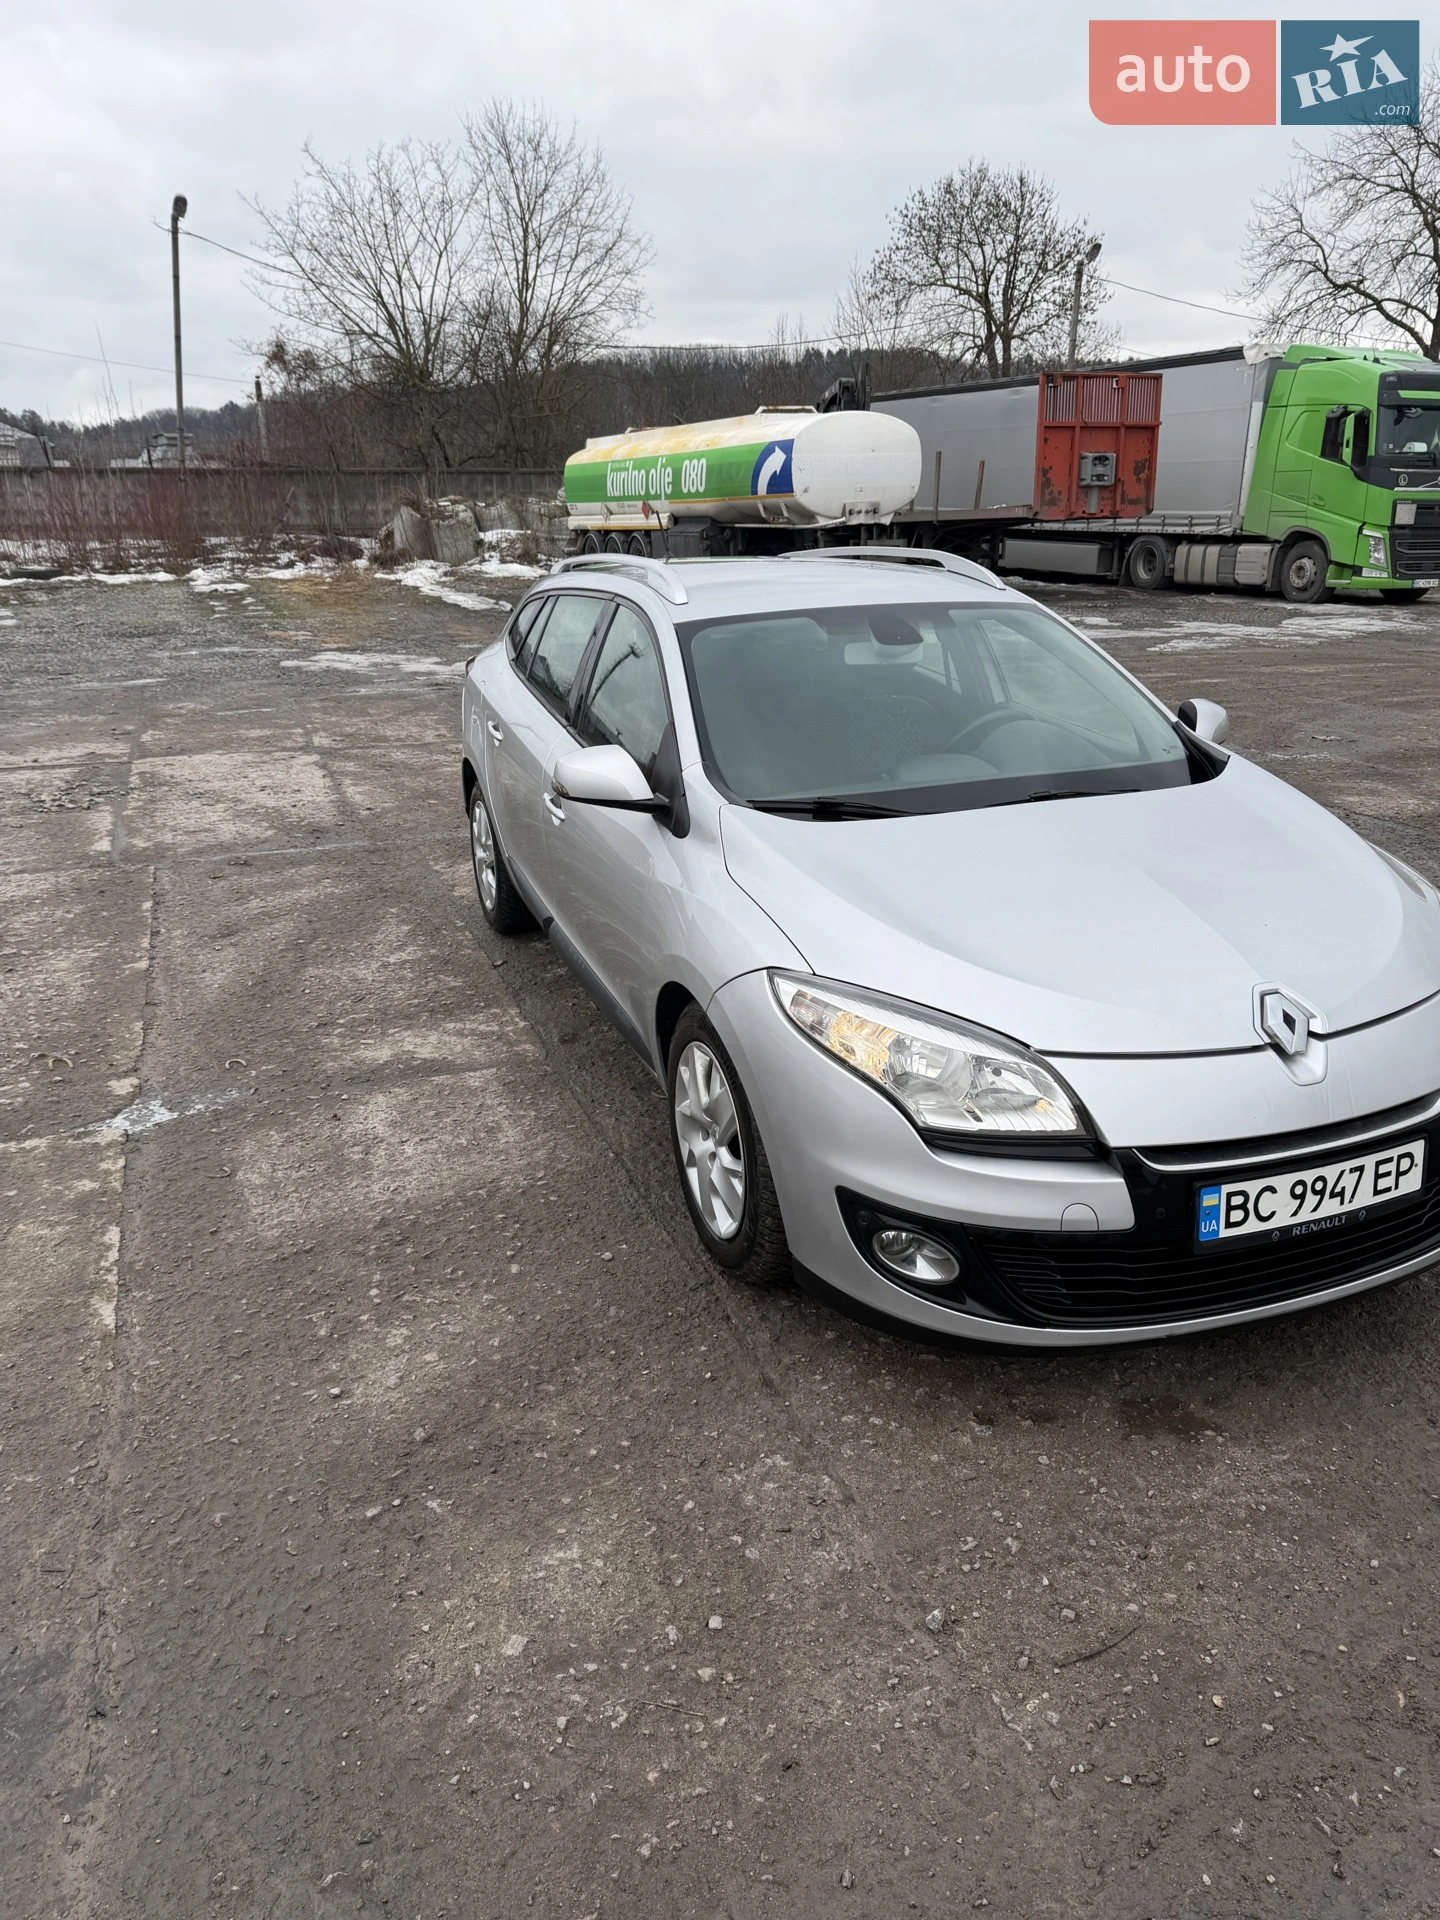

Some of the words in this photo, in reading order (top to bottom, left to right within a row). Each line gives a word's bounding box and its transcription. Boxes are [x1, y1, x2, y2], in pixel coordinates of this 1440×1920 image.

[606, 460, 646, 497] kurilno
[648, 456, 673, 501] olje
[681, 457, 707, 494] 080
[1224, 1184, 1278, 1229] BC
[1289, 1163, 1366, 1218] 9947
[1372, 1151, 1415, 1198] EP
[1201, 1219, 1218, 1233] UA
[1292, 1214, 1348, 1237] RENAULT
